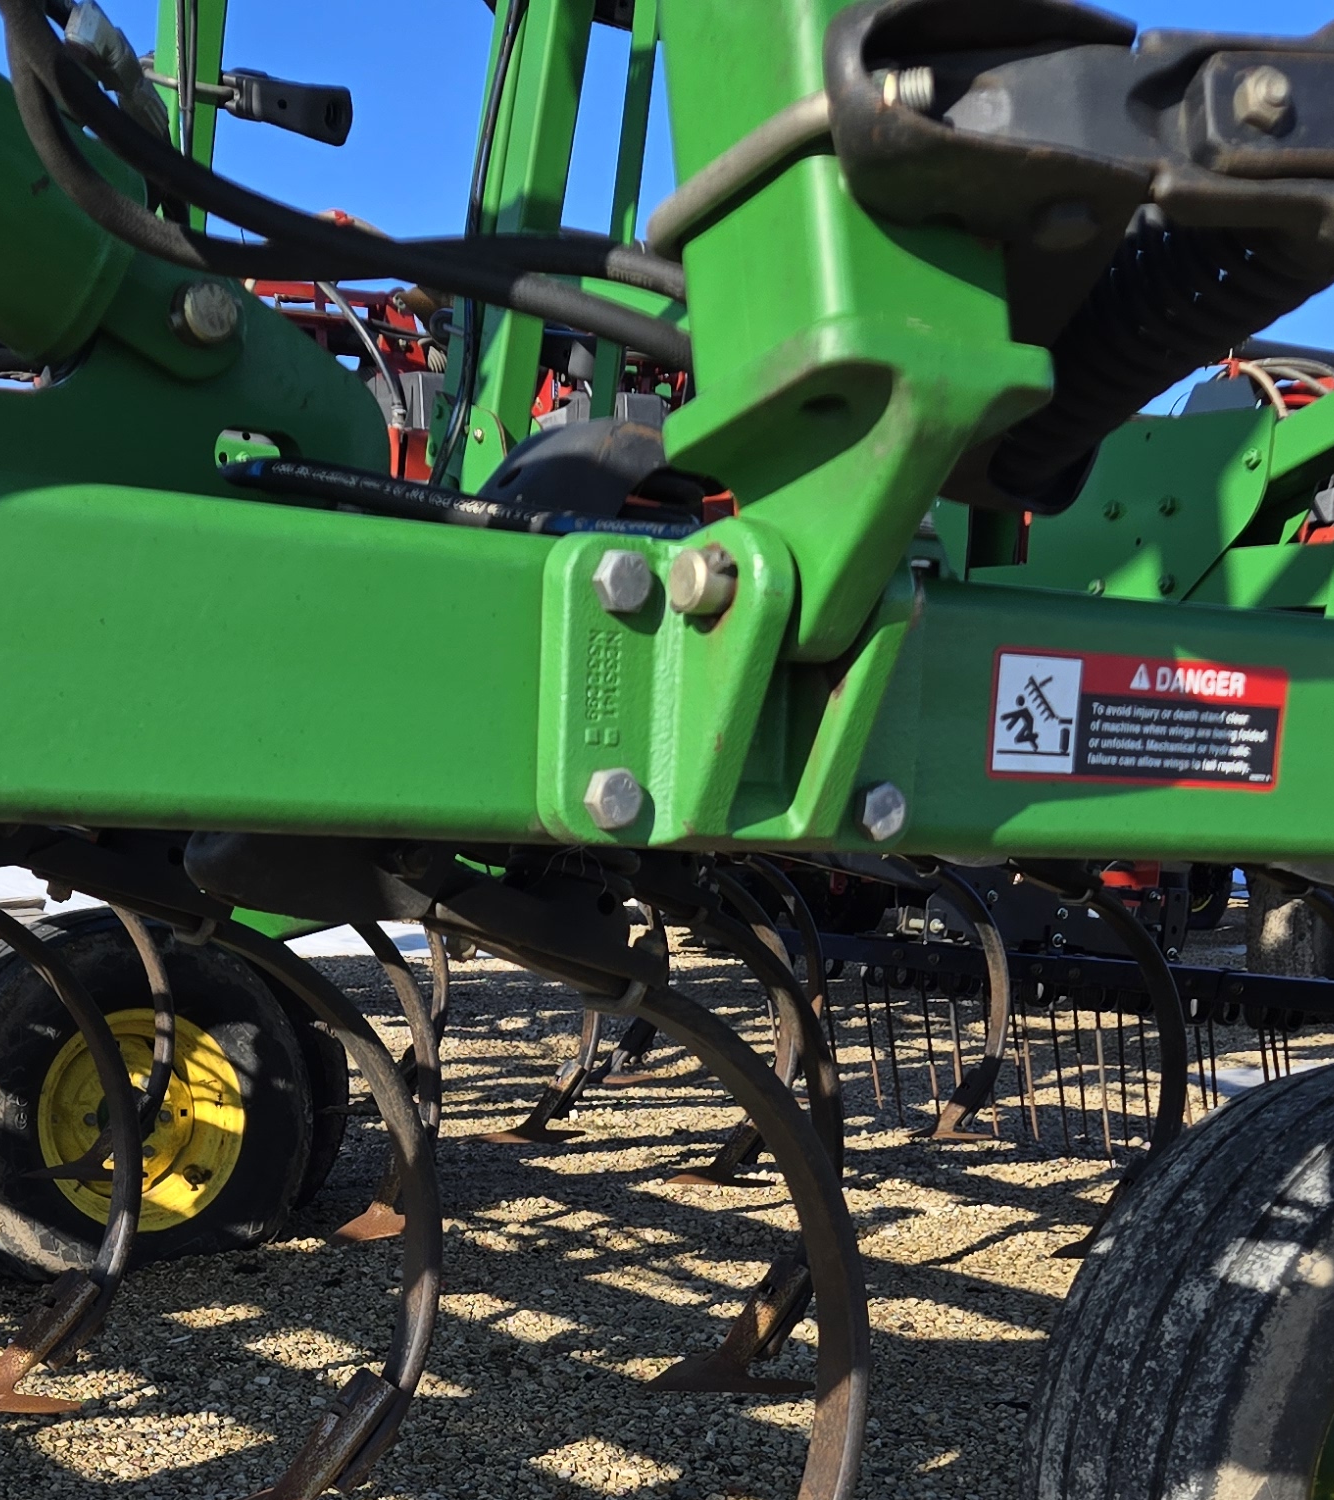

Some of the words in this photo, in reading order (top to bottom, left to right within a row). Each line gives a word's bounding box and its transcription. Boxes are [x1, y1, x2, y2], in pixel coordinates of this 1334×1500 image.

[1155, 666, 1246, 698] DANGER
[1092, 702, 1105, 715] To
[1105, 704, 1132, 717] avoid
[1133, 705, 1160, 721] injury
[1161, 709, 1172, 720] or
[1090, 719, 1101, 731] of
[1101, 720, 1141, 734] machine
[1142, 722, 1168, 735] when
[1169, 724, 1196, 739] wings
[1088, 738, 1100, 748] or
[1100, 738, 1144, 751] unfolded.
[1087, 752, 1118, 766] failure
[1119, 756, 1136, 767] can
[1137, 755, 1162, 768] allow
[1163, 758, 1190, 772] wings
